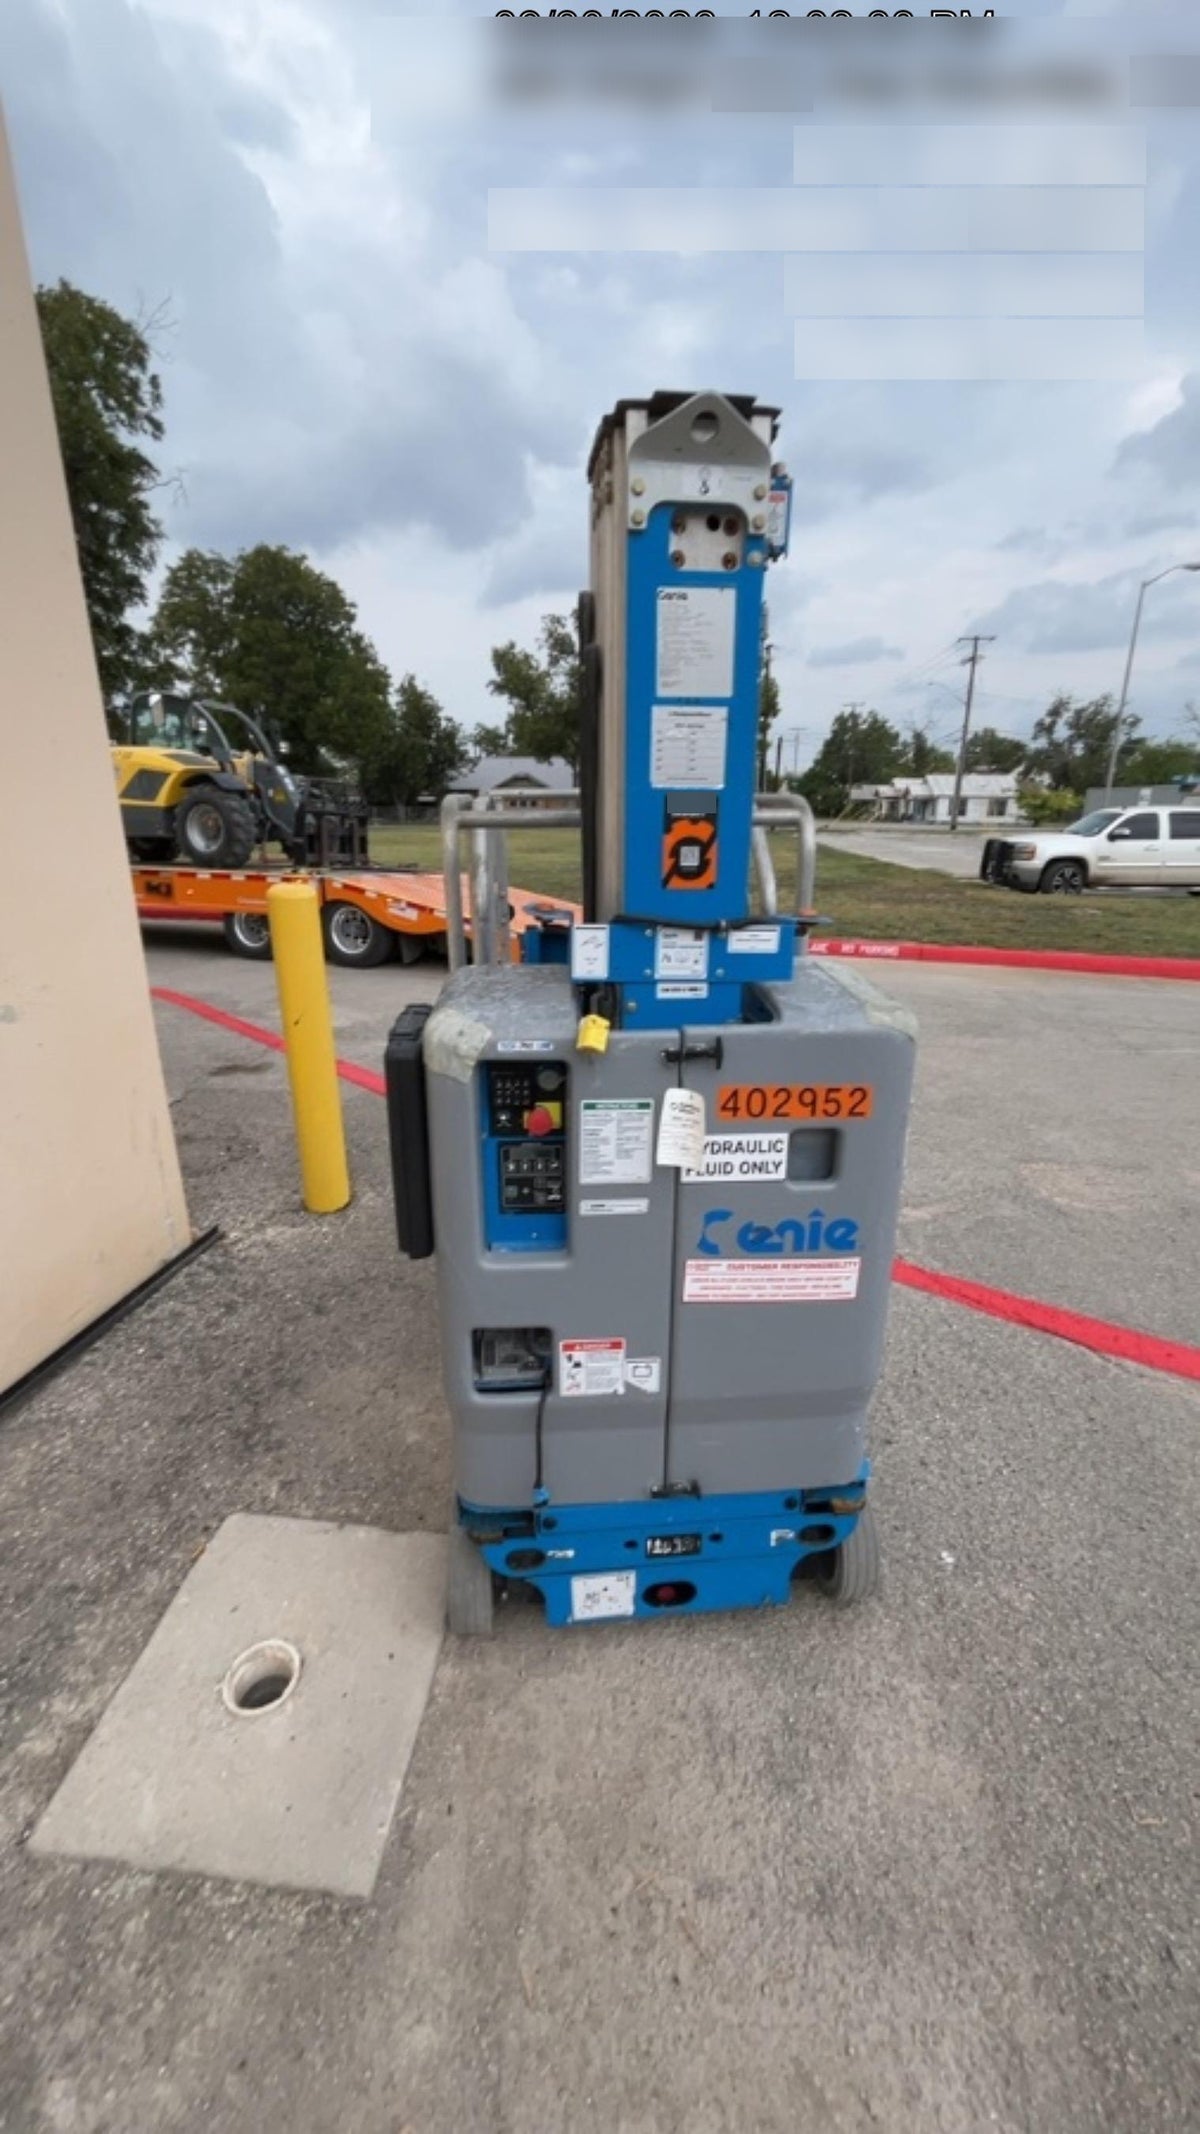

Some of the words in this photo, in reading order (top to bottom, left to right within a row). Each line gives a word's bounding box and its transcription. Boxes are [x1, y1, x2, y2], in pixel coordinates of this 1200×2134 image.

[720, 1087, 868, 1118] 402952
[703, 1139, 784, 1155] YDRAULIC
[739, 1159, 782, 1175] ONLY
